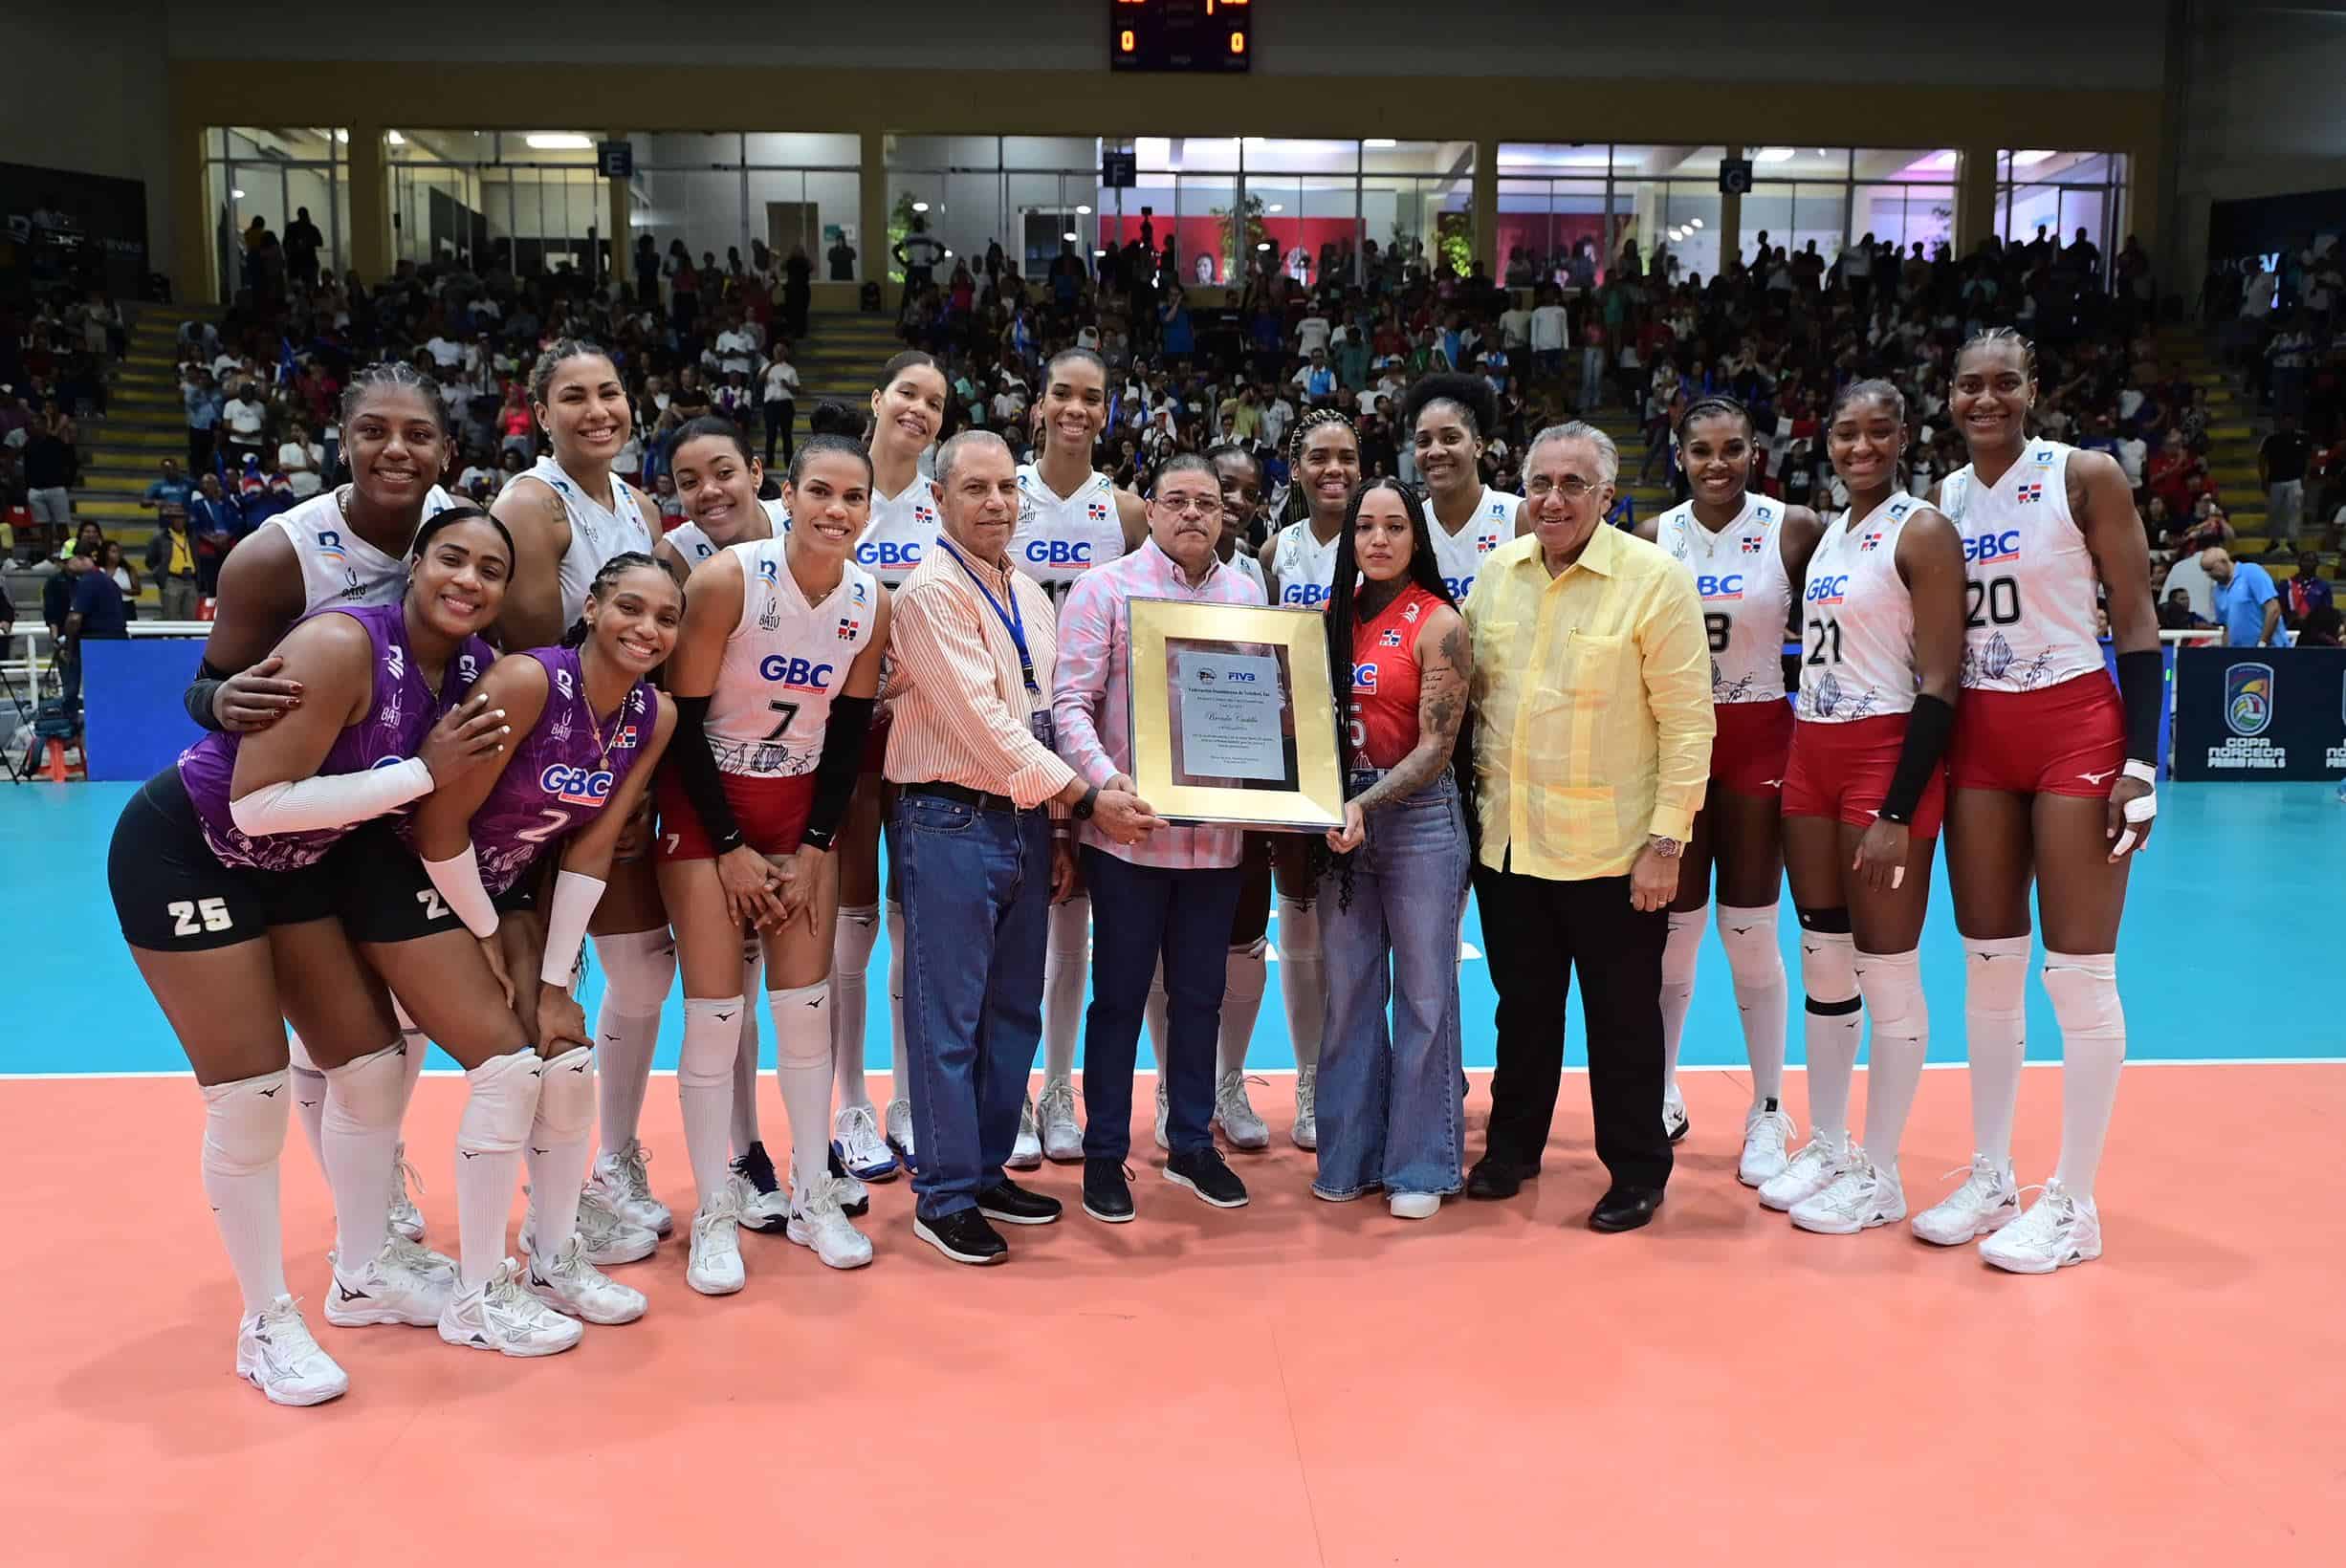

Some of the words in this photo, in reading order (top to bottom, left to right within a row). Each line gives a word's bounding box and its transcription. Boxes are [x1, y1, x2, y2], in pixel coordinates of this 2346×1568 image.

[1122, 31, 1133, 52] 0
[1232, 33, 1243, 53] 0
[607, 153, 625, 174] E
[1112, 163, 1126, 185] F
[1726, 169, 1745, 191] G
[856, 542, 922, 564] GBC
[1025, 540, 1091, 562] GBC
[1961, 530, 2020, 562] GBC
[1442, 576, 1475, 599] BC
[1697, 574, 1743, 597] BC
[1806, 575, 1848, 601] GBC
[1965, 577, 2021, 628] 20
[1807, 619, 1842, 665] 21
[759, 654, 834, 688] GBC
[1228, 672, 1256, 682] FIVB
[761, 700, 800, 741] 7
[2226, 738, 2270, 748] COPA
[540, 764, 613, 798] GBC
[517, 809, 571, 842] 2
[667, 833, 680, 855] 7
[415, 888, 450, 920] 2
[167, 897, 233, 936] 25
